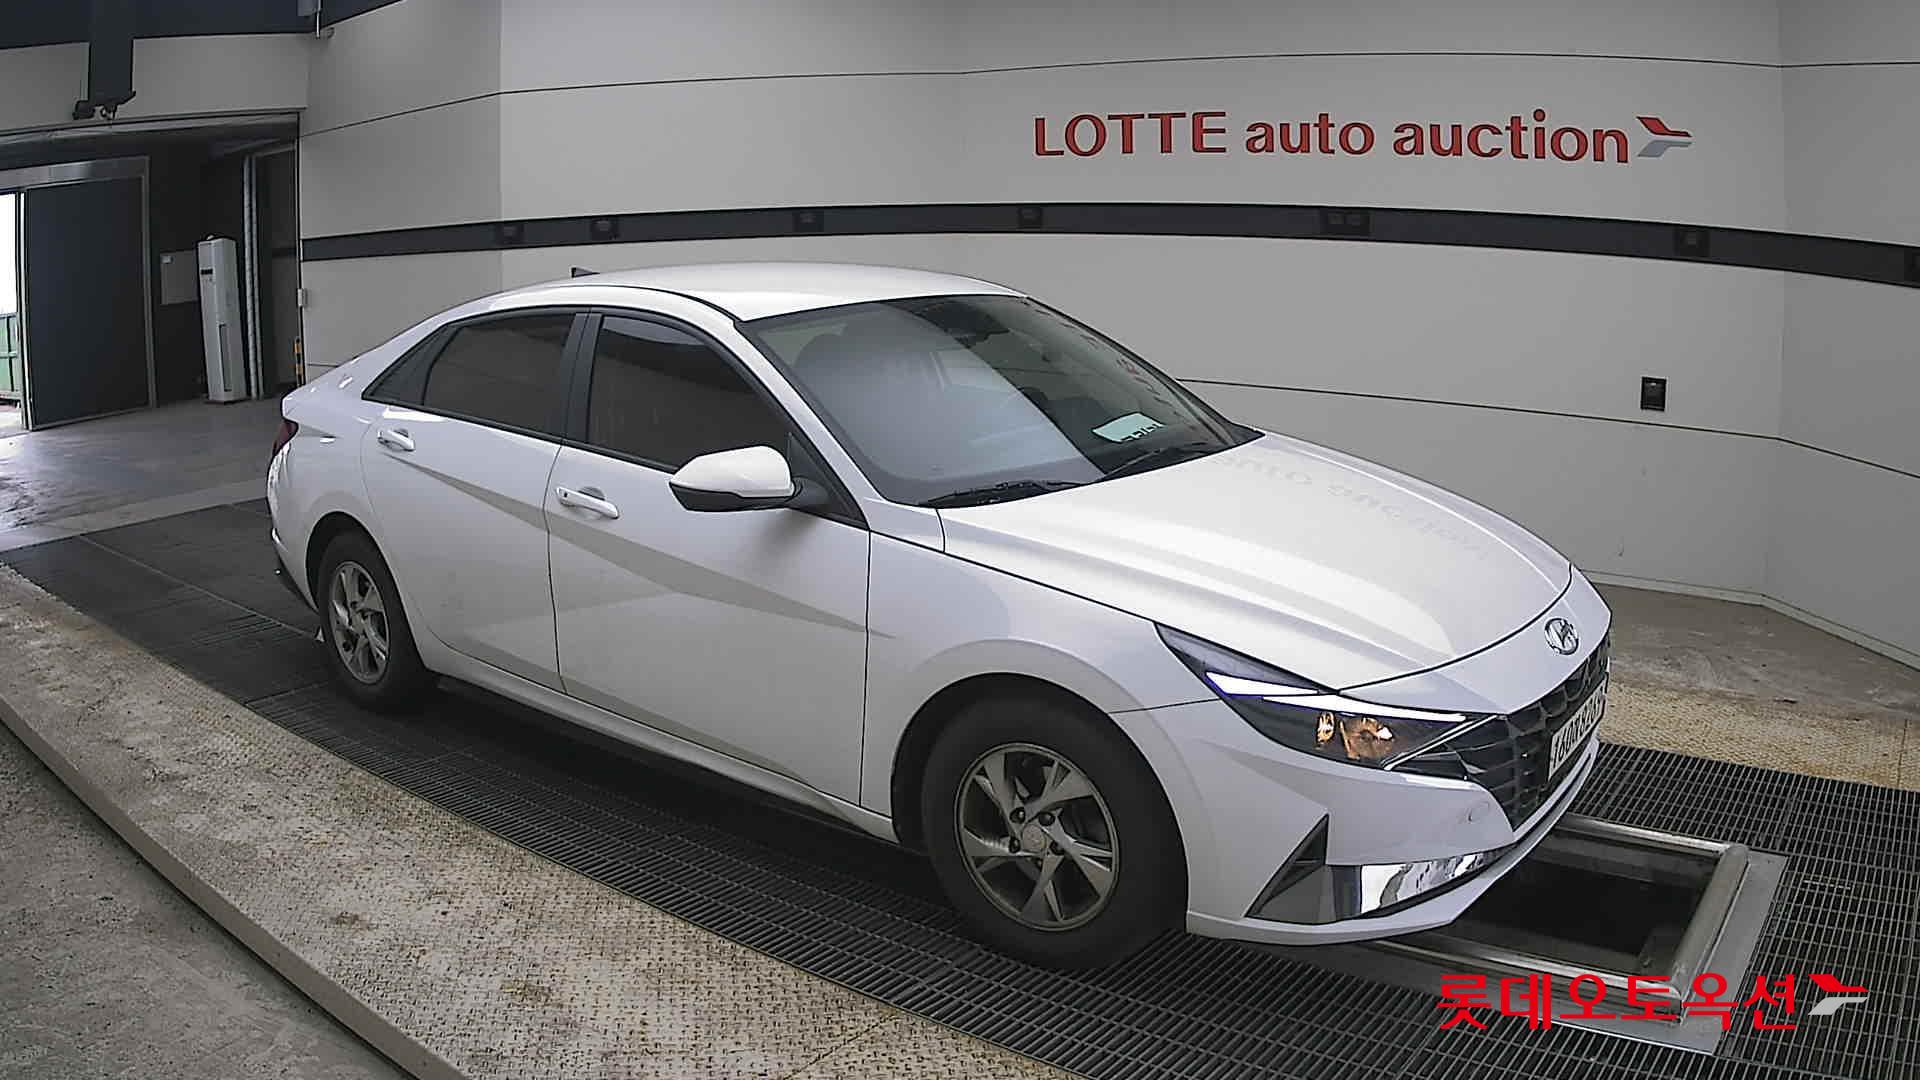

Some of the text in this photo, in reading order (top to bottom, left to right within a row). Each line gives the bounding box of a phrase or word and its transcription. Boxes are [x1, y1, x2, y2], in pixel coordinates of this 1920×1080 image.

[1034, 109, 1629, 163] LOTTE auto auction
